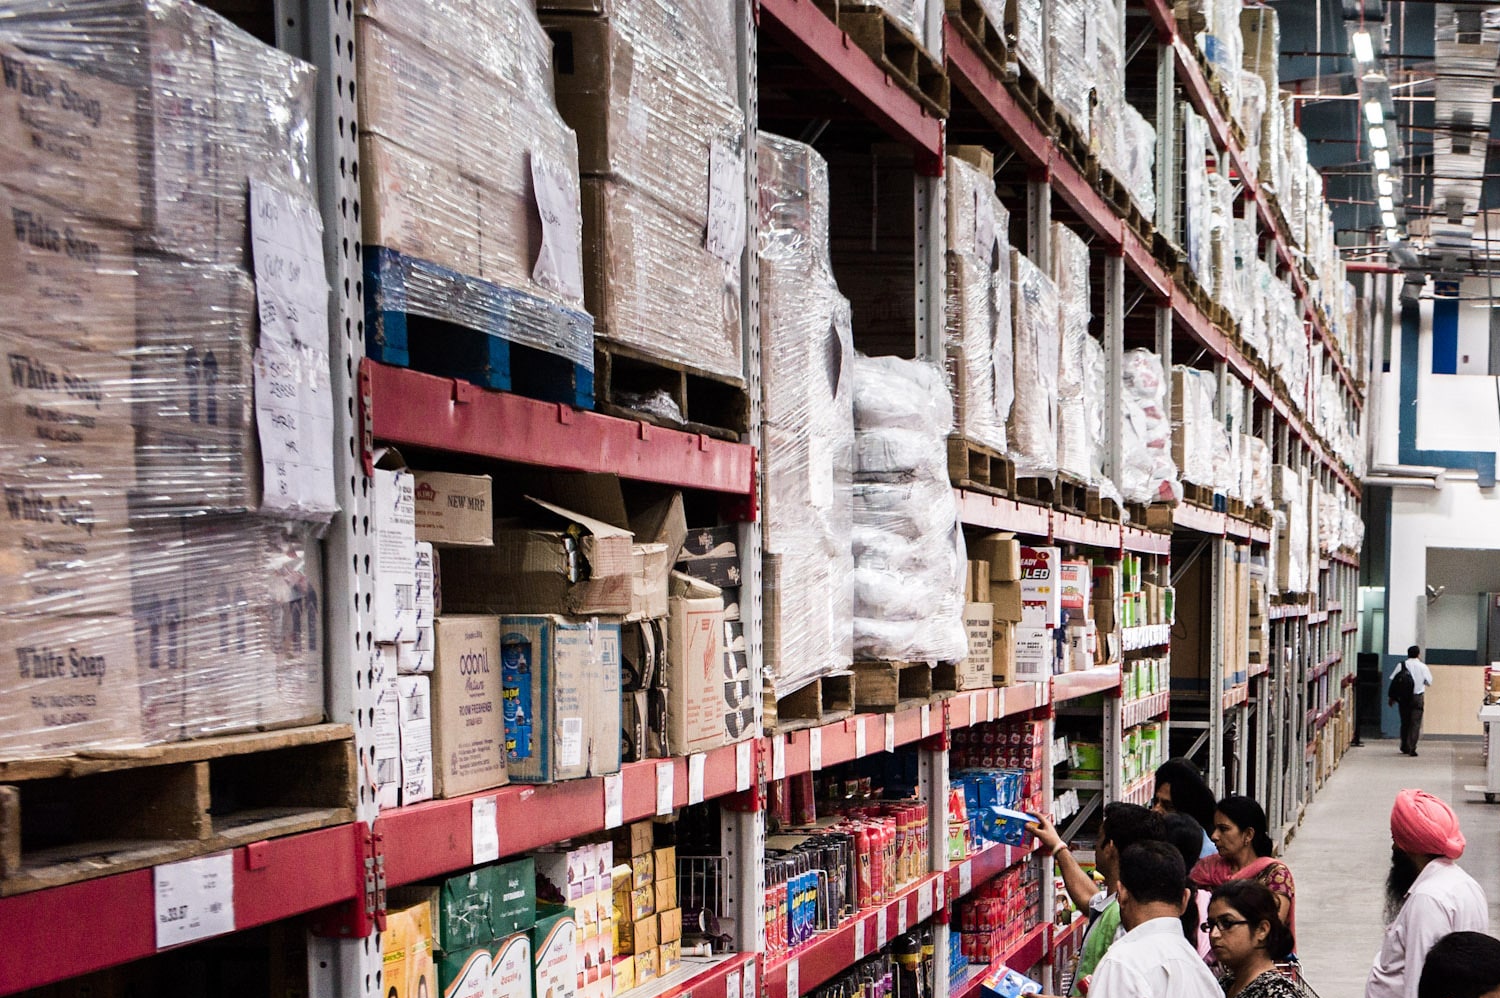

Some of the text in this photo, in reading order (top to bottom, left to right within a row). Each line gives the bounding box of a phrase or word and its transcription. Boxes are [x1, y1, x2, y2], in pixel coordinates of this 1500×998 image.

[447, 495, 485, 512] NEW MRP
[69, 647, 106, 685] Soap
[460, 649, 490, 677] odonil
